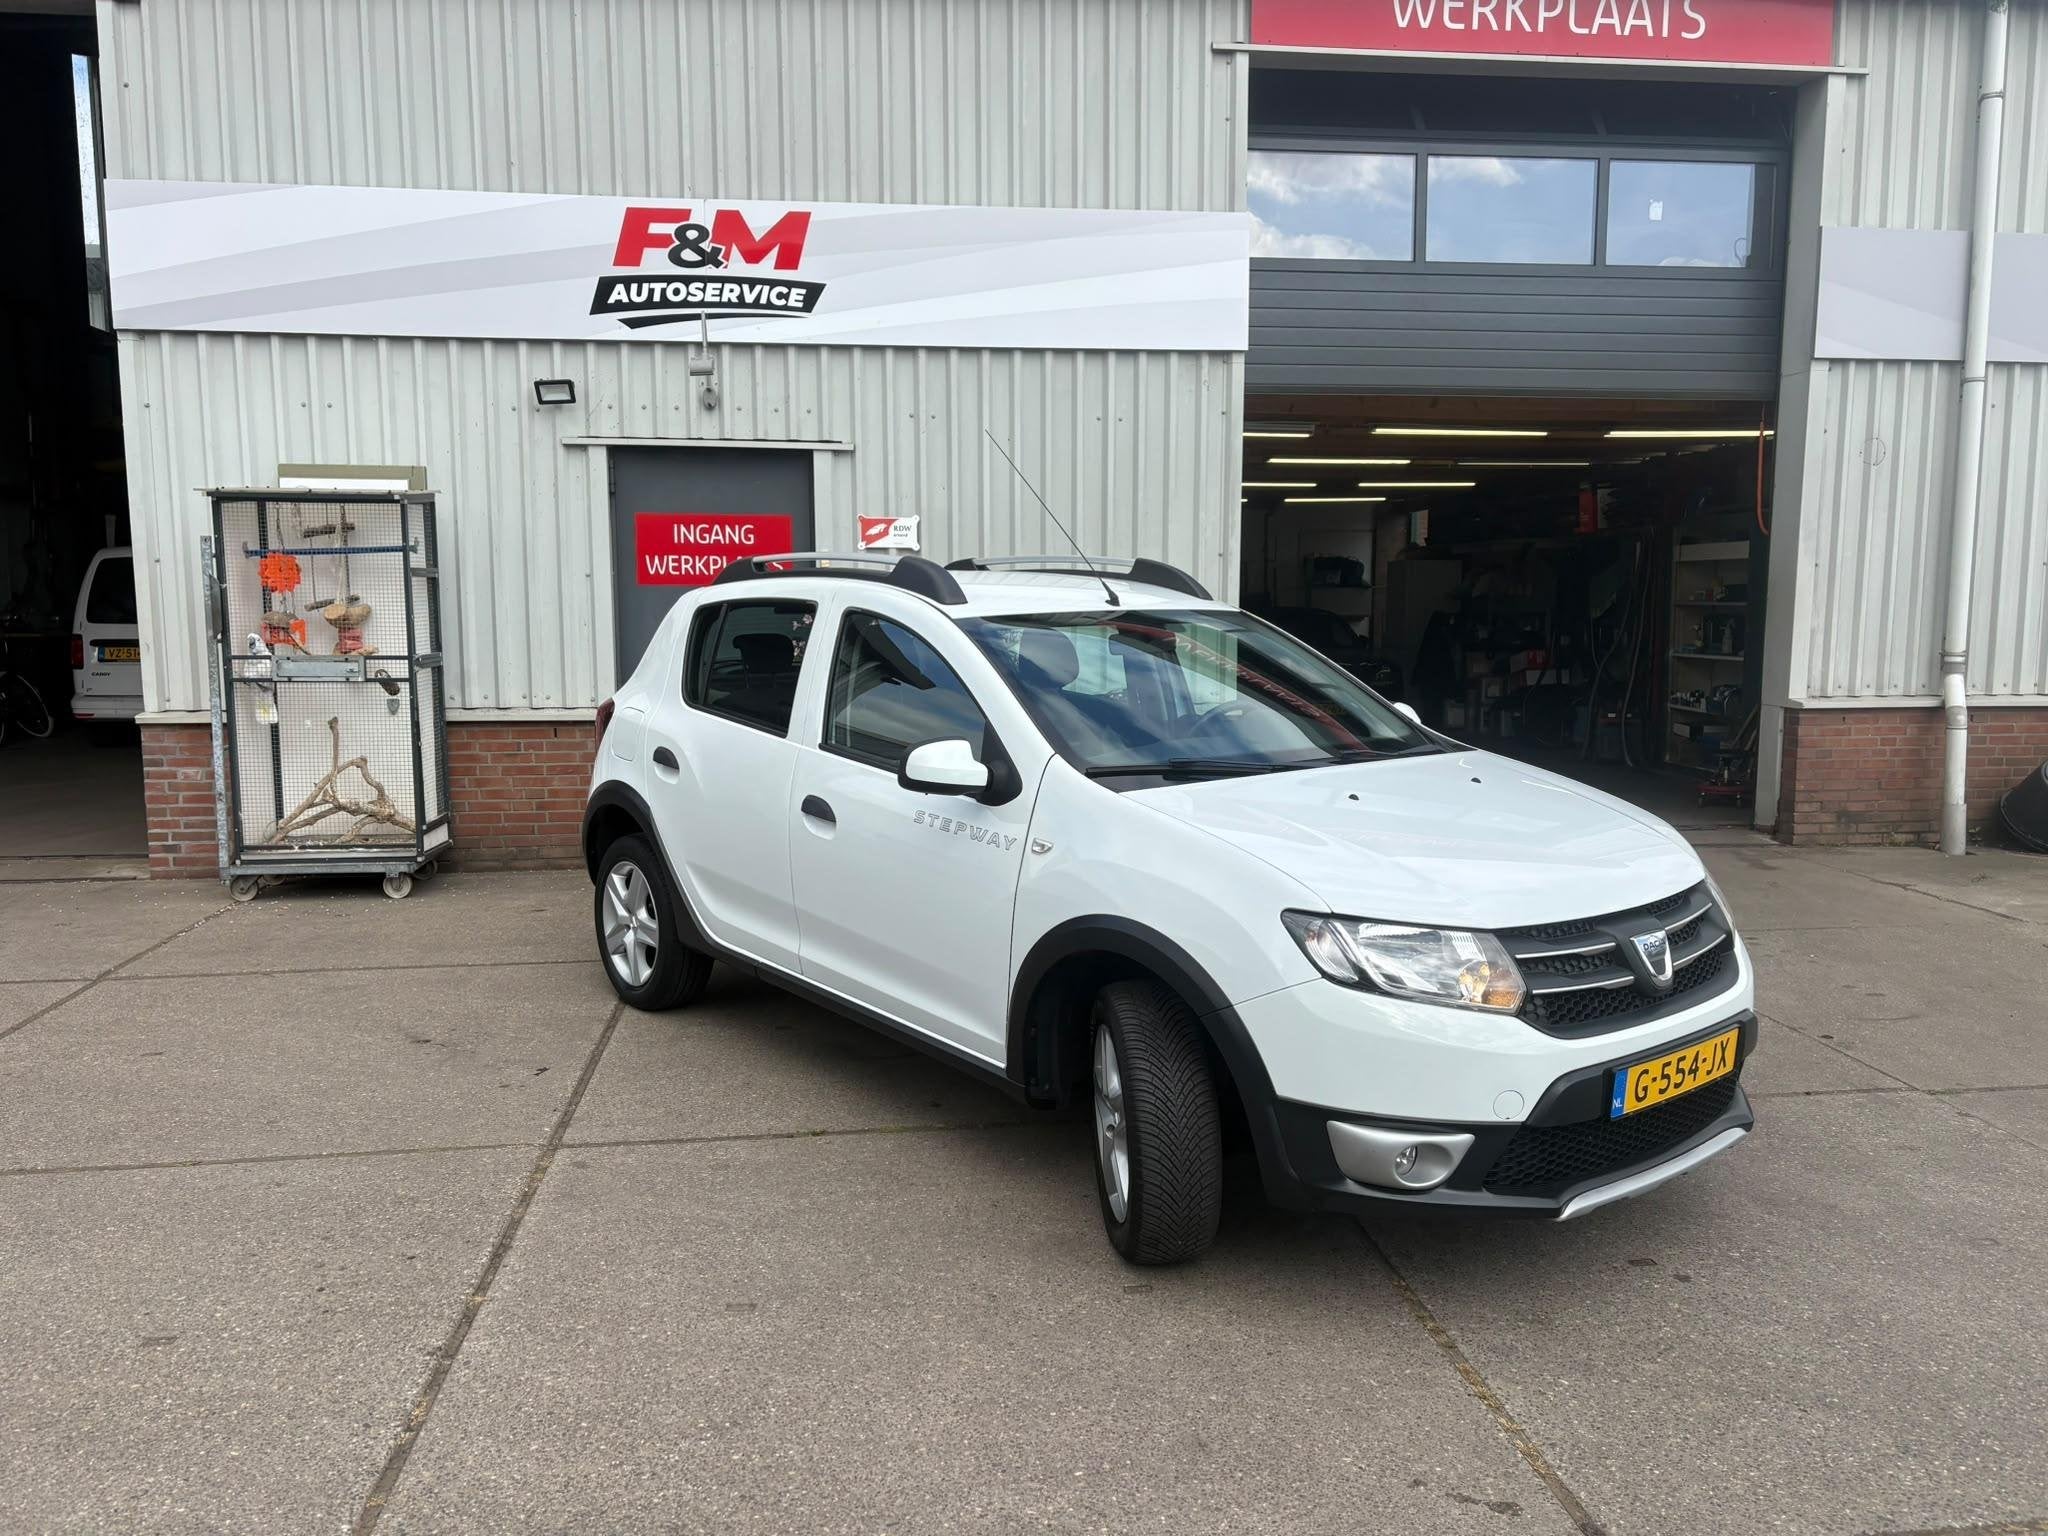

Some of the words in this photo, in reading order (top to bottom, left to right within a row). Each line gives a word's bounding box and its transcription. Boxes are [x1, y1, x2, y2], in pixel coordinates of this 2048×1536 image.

[1392, 0, 1707, 40] WERKPLAATS
[612, 206, 812, 271] F&M
[607, 281, 807, 308] AUTOSERVICE
[672, 523, 755, 546] INGANG
[893, 524, 912, 532] RDW
[645, 555, 783, 576] WERKP
[913, 809, 1018, 851] STEPWAY
[1634, 1036, 1730, 1103] G-554-JX
[1612, 1097, 1623, 1109] NL
